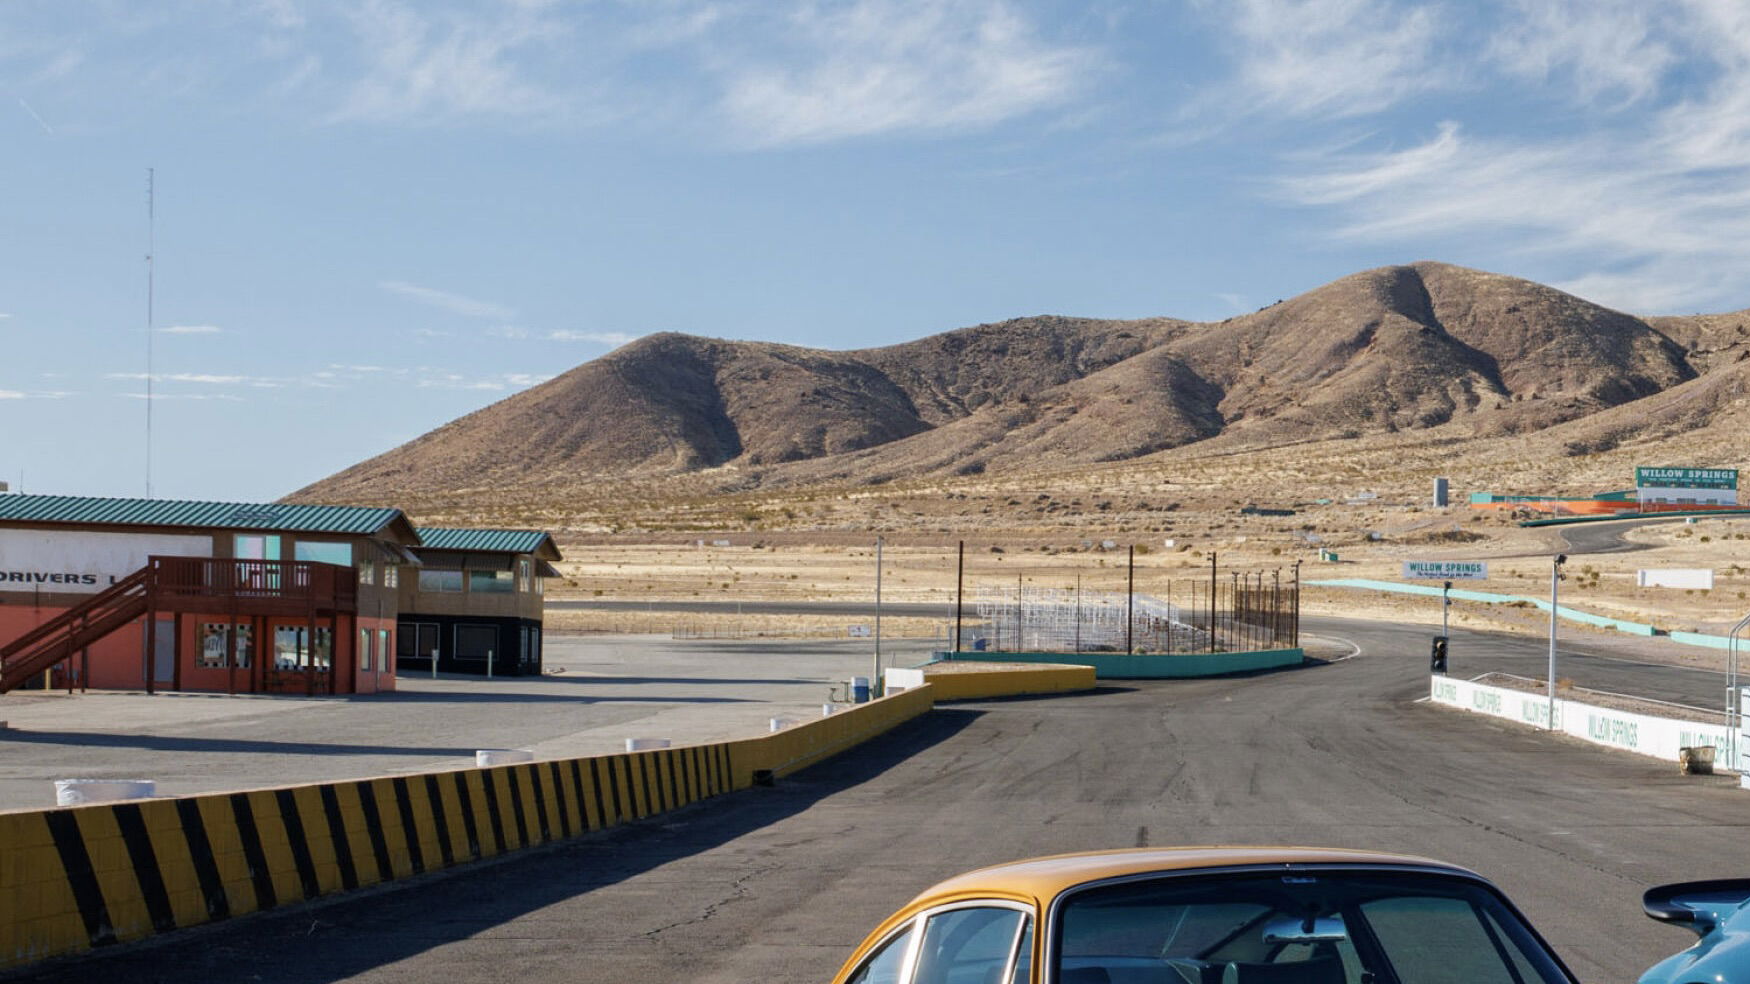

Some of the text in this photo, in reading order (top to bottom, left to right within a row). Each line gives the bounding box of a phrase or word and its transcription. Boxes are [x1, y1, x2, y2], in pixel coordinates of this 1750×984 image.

[1640, 469, 1735, 479] WILLOW SPRINGS
[1409, 562, 1482, 572] WILLOW SPRINGS
